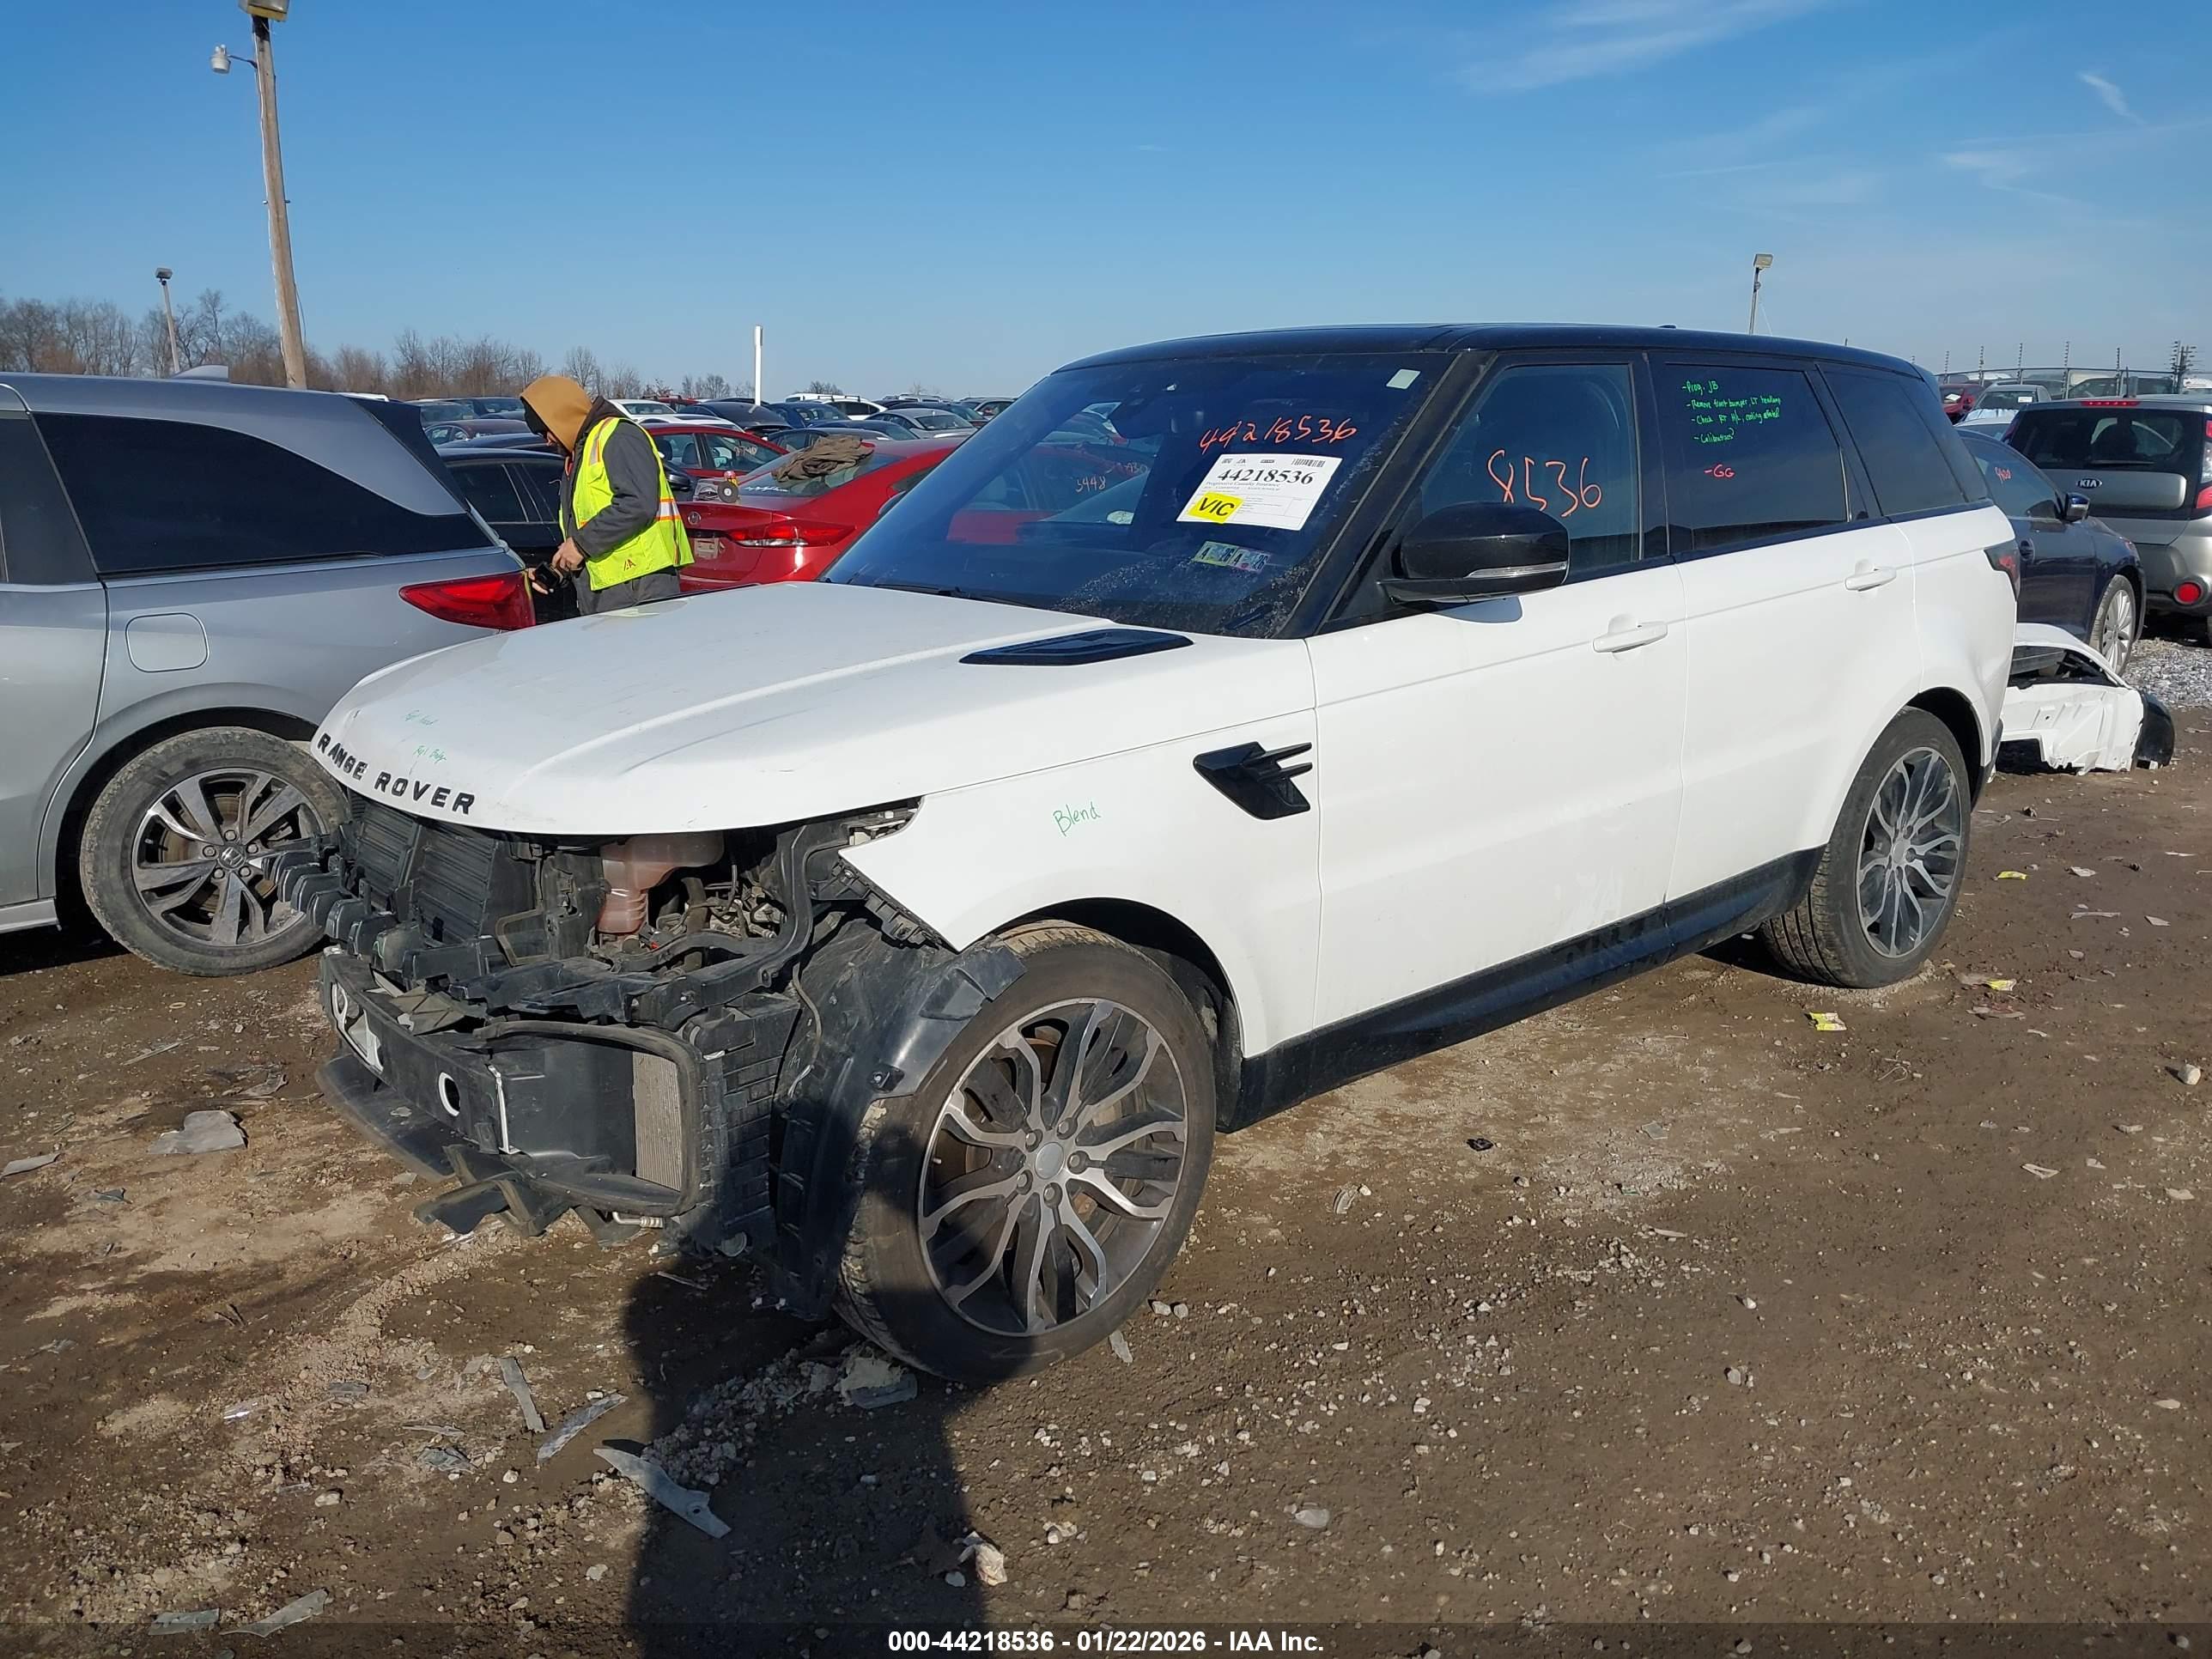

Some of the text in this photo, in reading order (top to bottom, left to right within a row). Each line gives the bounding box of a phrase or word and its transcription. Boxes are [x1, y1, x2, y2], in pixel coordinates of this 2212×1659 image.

[1200, 415, 1358, 455] 44218536
[1218, 469, 1317, 485] 44218536
[1487, 449, 1602, 517] 8536
[1199, 498, 1235, 516] VIC
[317, 732, 368, 780] RANGE
[374, 771, 476, 816] ROVER
[1053, 800, 1102, 837] Blend
